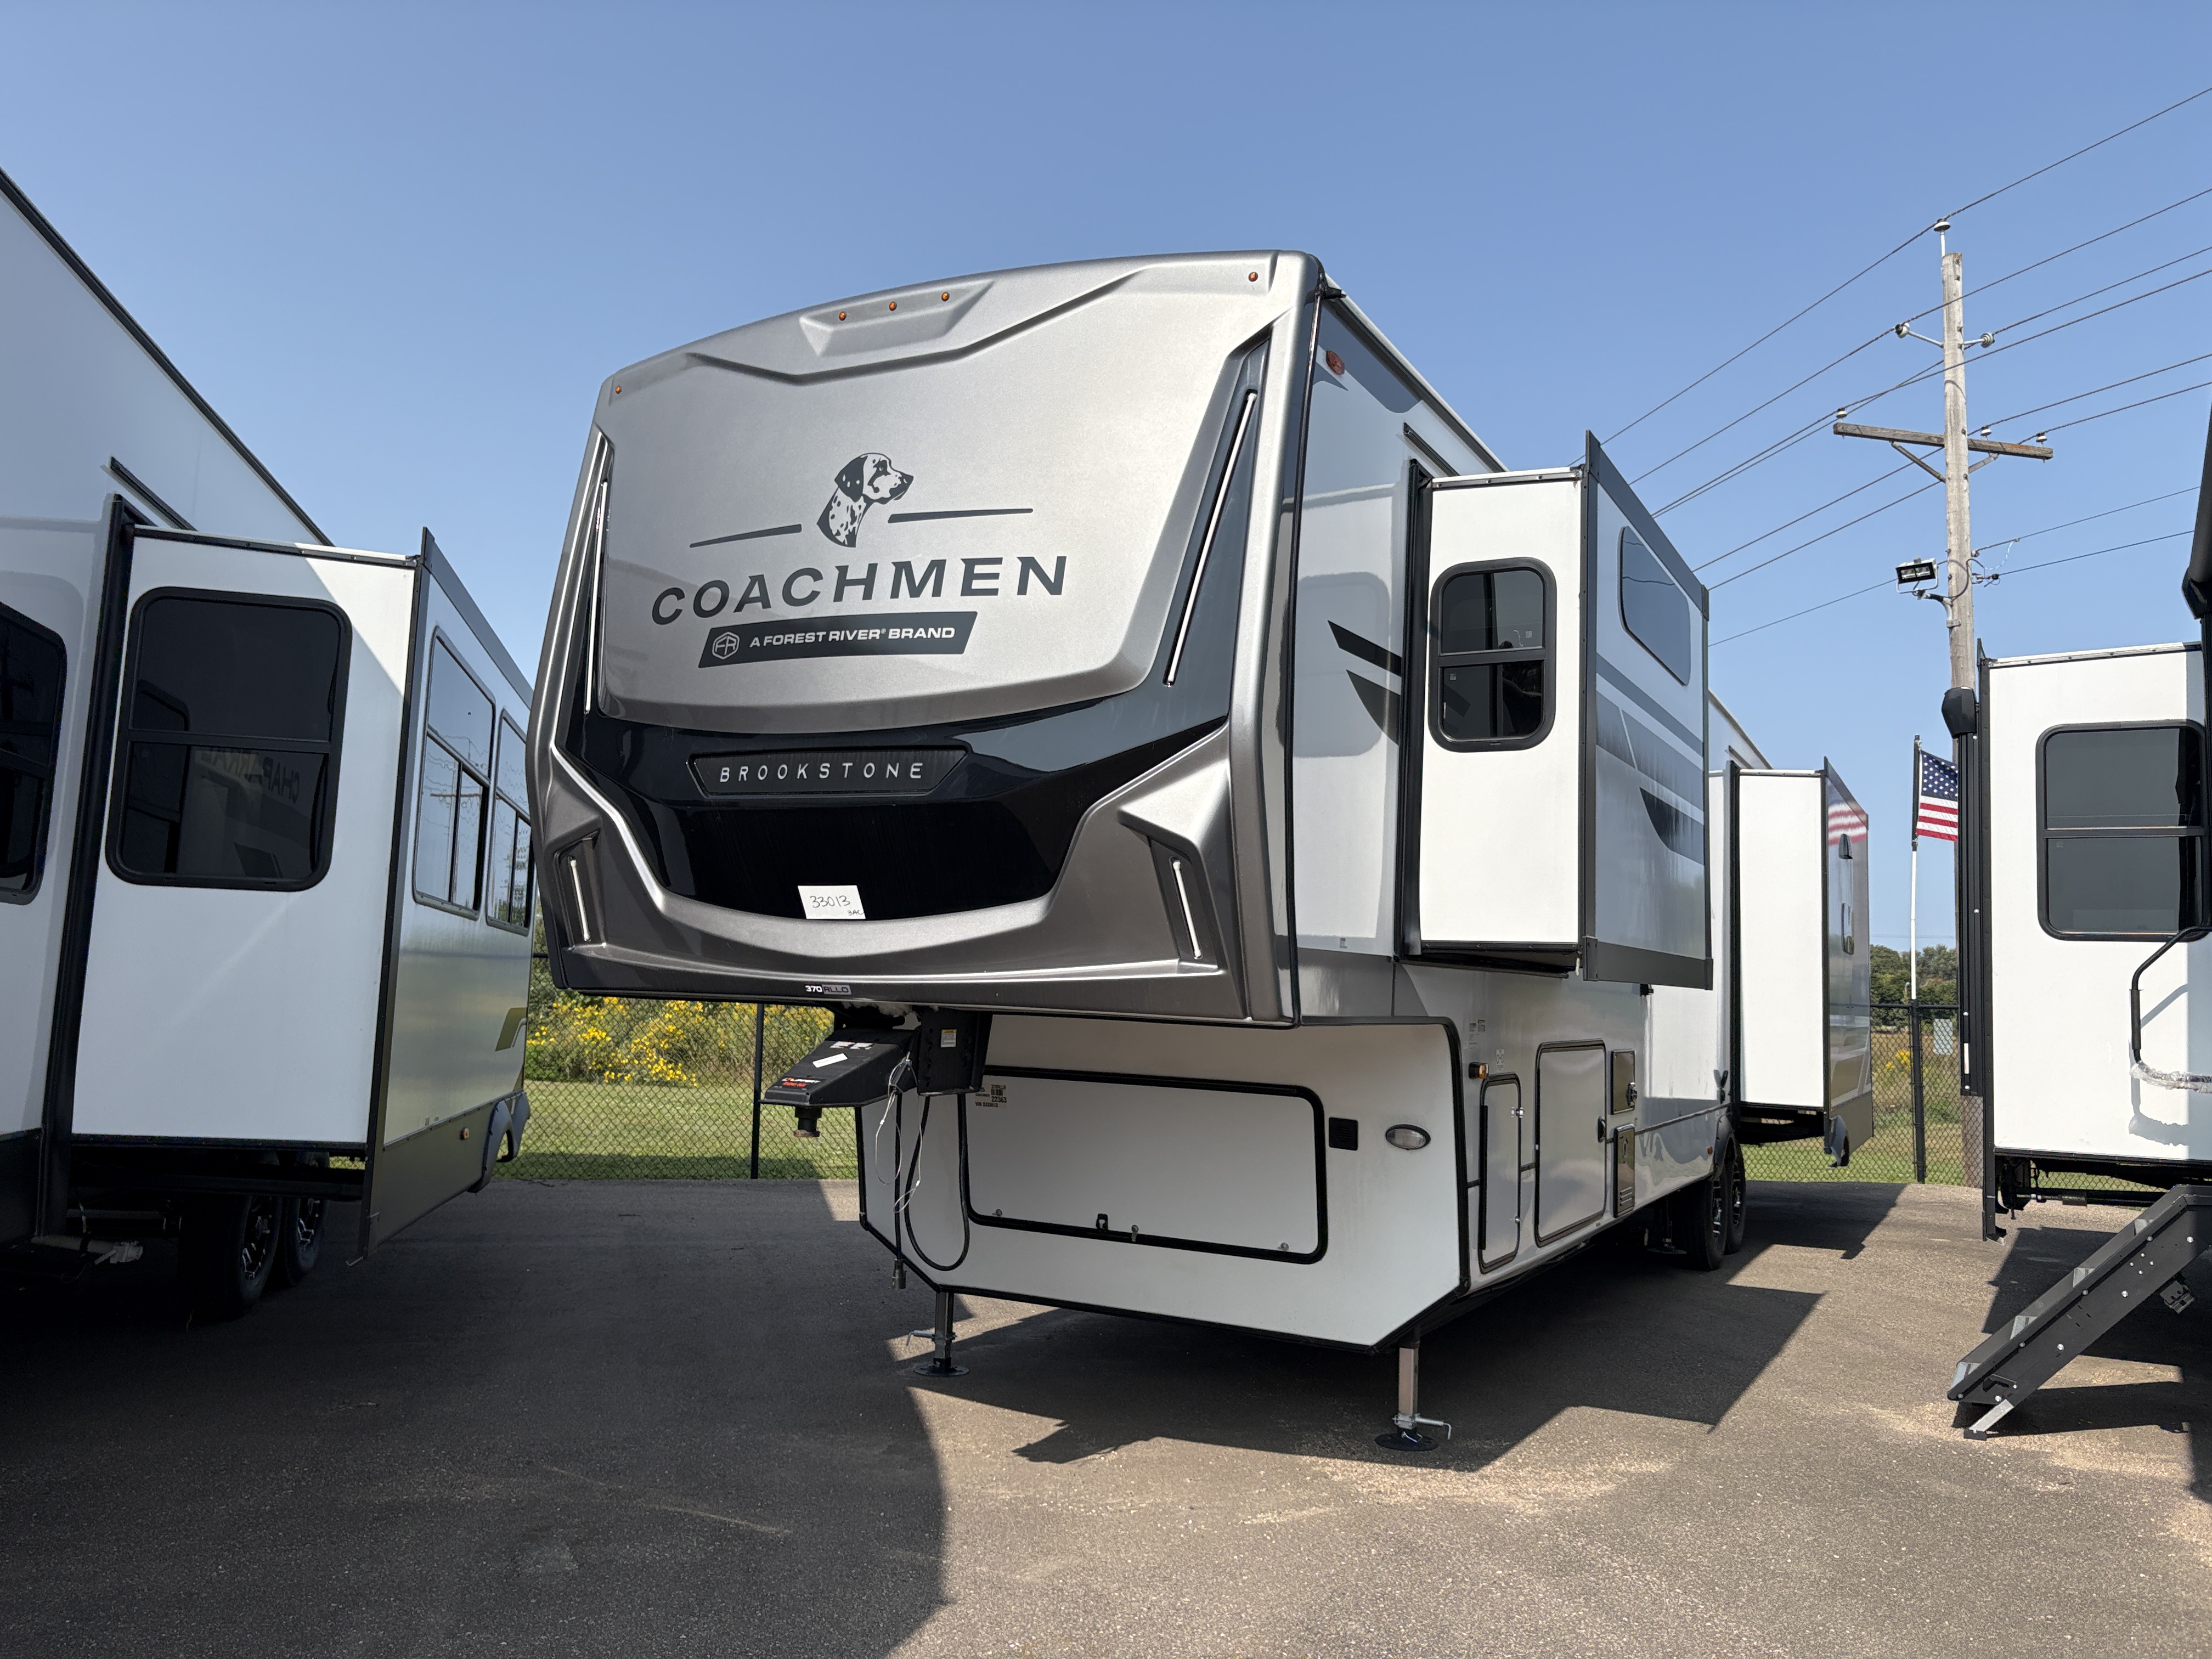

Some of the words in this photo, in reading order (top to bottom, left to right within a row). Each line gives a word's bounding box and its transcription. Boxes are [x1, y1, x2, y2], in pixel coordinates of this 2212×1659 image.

[652, 556, 1066, 625] COACHMEN
[749, 637, 760, 648] A
[763, 631, 827, 647] FOREST
[888, 627, 955, 639] BRAND
[719, 763, 923, 783] BROOKSTONE
[810, 895, 850, 908] 33013
